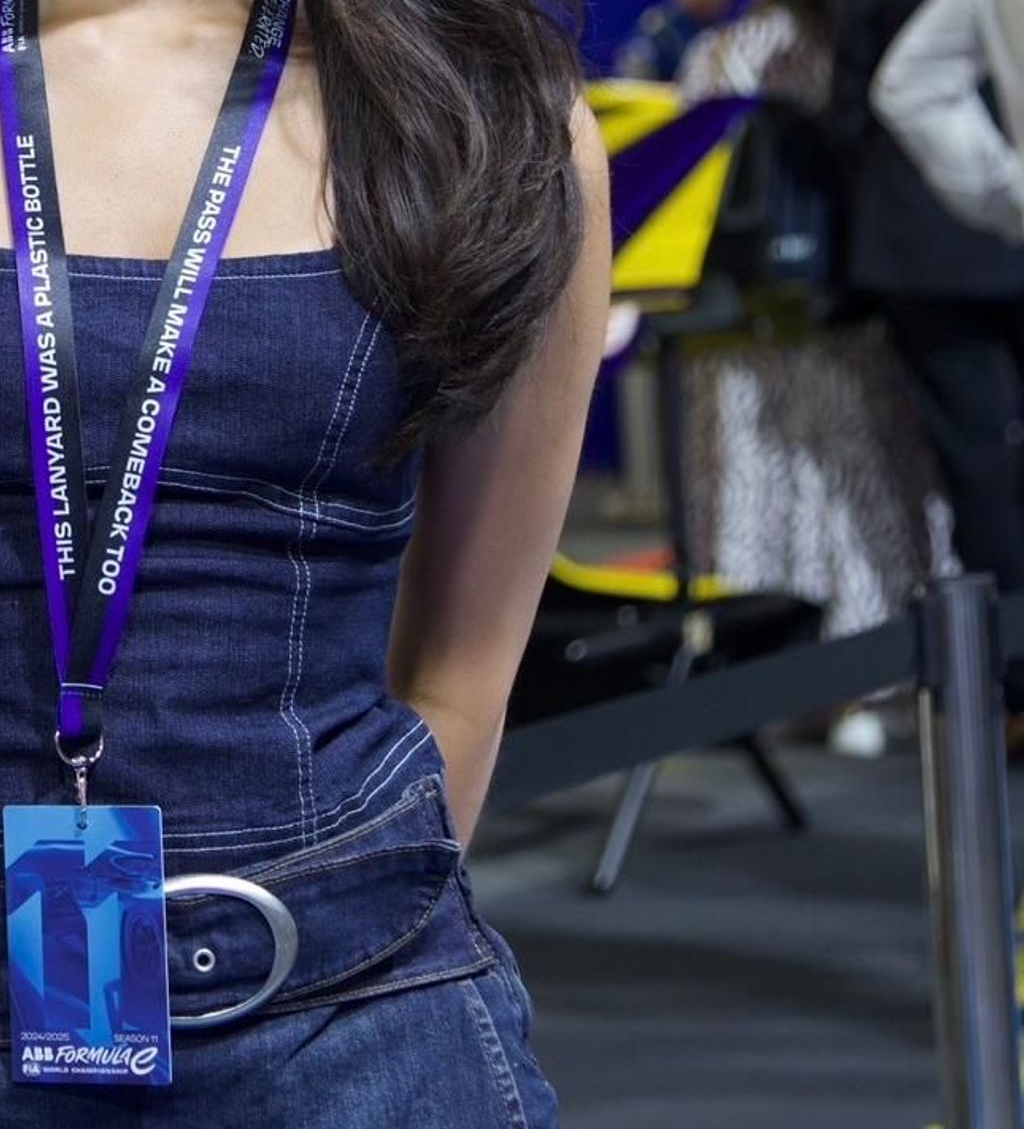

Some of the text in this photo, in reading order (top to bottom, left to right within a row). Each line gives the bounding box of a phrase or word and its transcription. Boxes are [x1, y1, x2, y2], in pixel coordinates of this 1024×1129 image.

[16, 133, 76, 581] THIS LANYARD WAS A PLASTIC BOTTLE
[97, 144, 242, 596] THE PASS WILL MAKE A COMEBACK TOO
[20, 1032, 71, 1042] 2024/2025
[113, 1033, 150, 1044] SEASON
[21, 1046, 54, 1061] ABB
[54, 1045, 133, 1065] FORMULA
